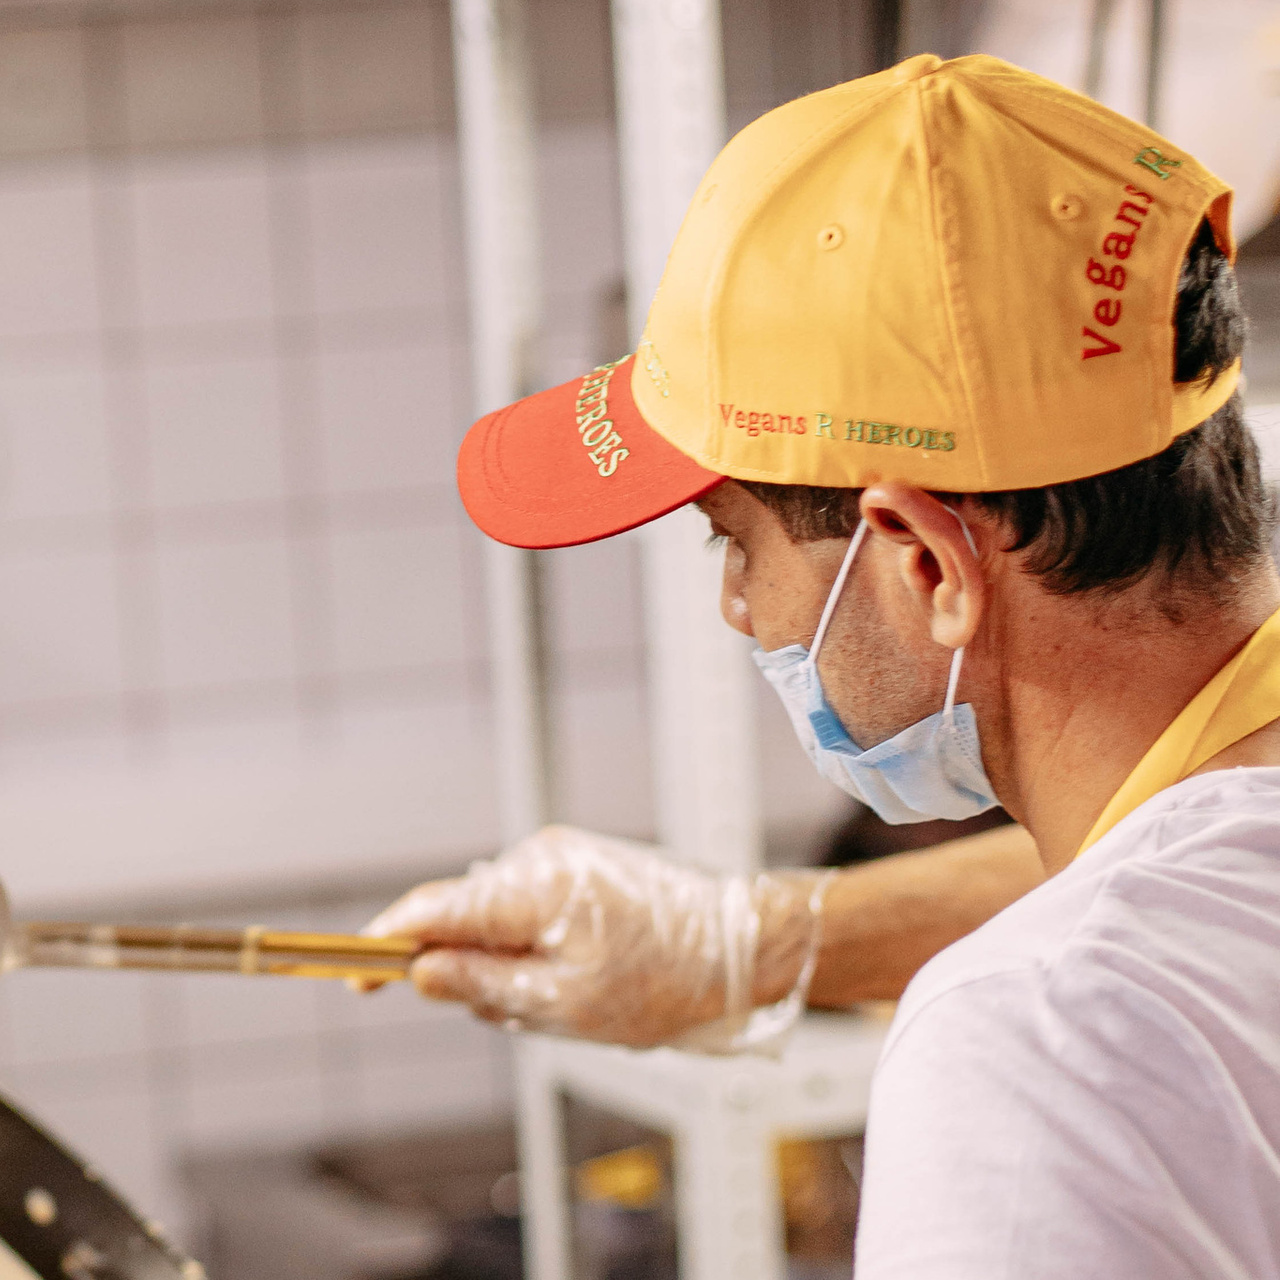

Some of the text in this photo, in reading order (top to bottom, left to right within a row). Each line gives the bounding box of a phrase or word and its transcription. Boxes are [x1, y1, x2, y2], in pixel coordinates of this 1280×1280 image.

[1081, 145, 1184, 361] Vegans R
[718, 402, 957, 452] Vegans R HEROES
